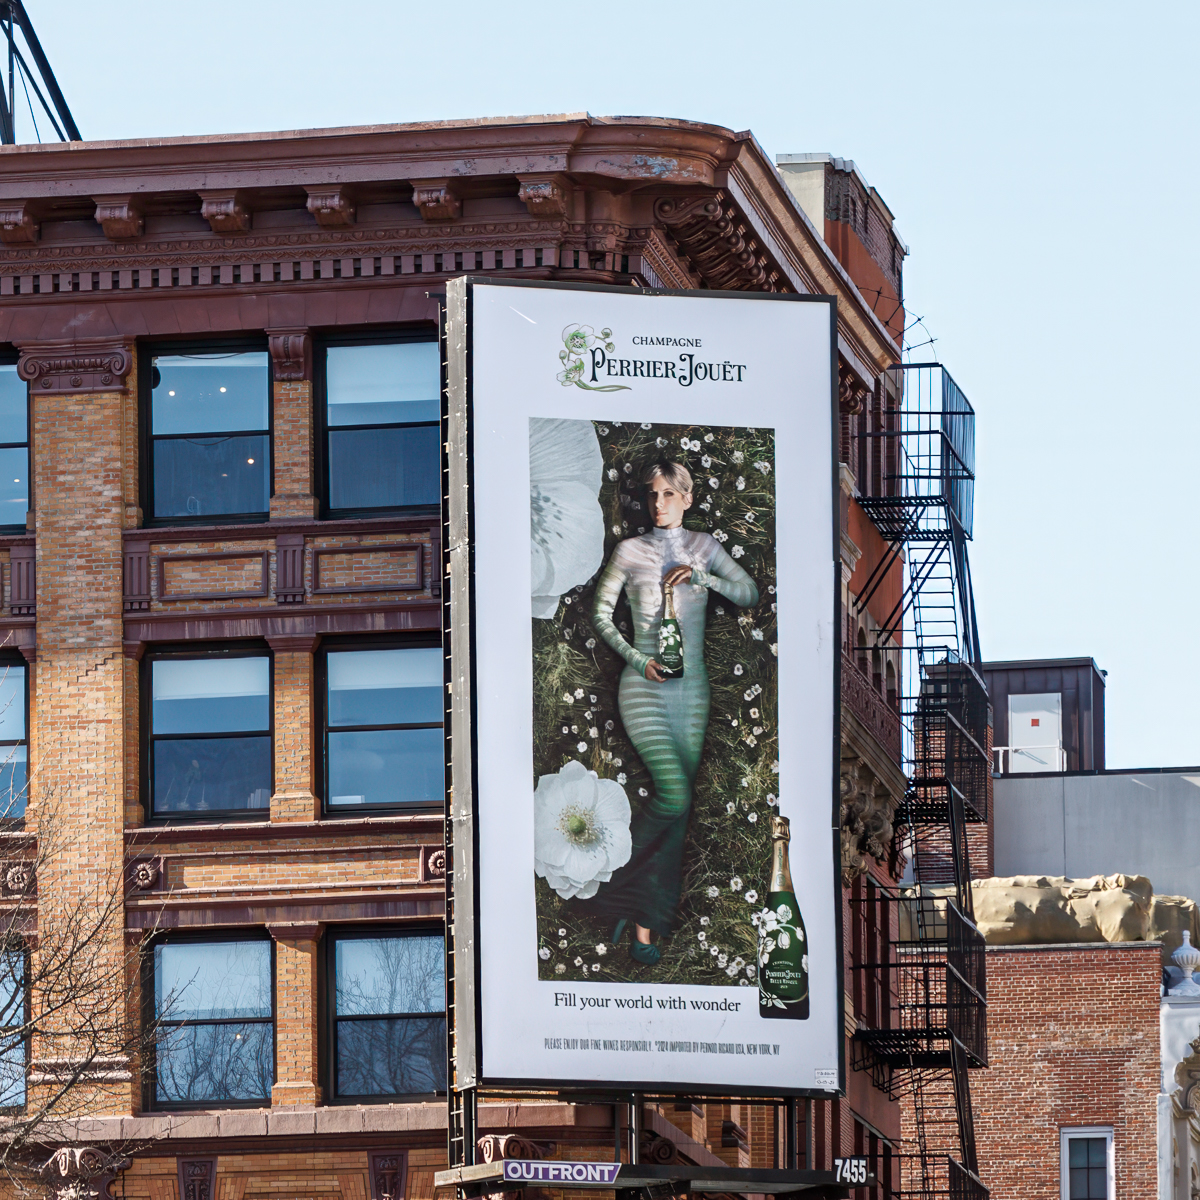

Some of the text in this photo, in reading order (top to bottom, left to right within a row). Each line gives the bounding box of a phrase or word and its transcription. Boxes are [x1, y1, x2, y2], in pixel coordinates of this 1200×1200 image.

[632, 336, 702, 348] CHAMPAGNE
[589, 347, 747, 387] PERRIER-JOUËT
[554, 992, 742, 1012] Fill your world with wonder
[544, 1037, 562, 1050] PLEASE
[563, 1038, 578, 1050] ENJOY
[579, 1039, 589, 1050] OUR
[590, 1039, 601, 1051] FINE
[602, 1039, 619, 1052] WINES
[669, 1041, 692, 1053] IMPORTED
[692, 1042, 699, 1053] BY
[746, 1043, 758, 1055] NEW
[772, 1044, 781, 1056] NY
[507, 1162, 615, 1182] OUTFRONT
[834, 1158, 867, 1183] 7455
